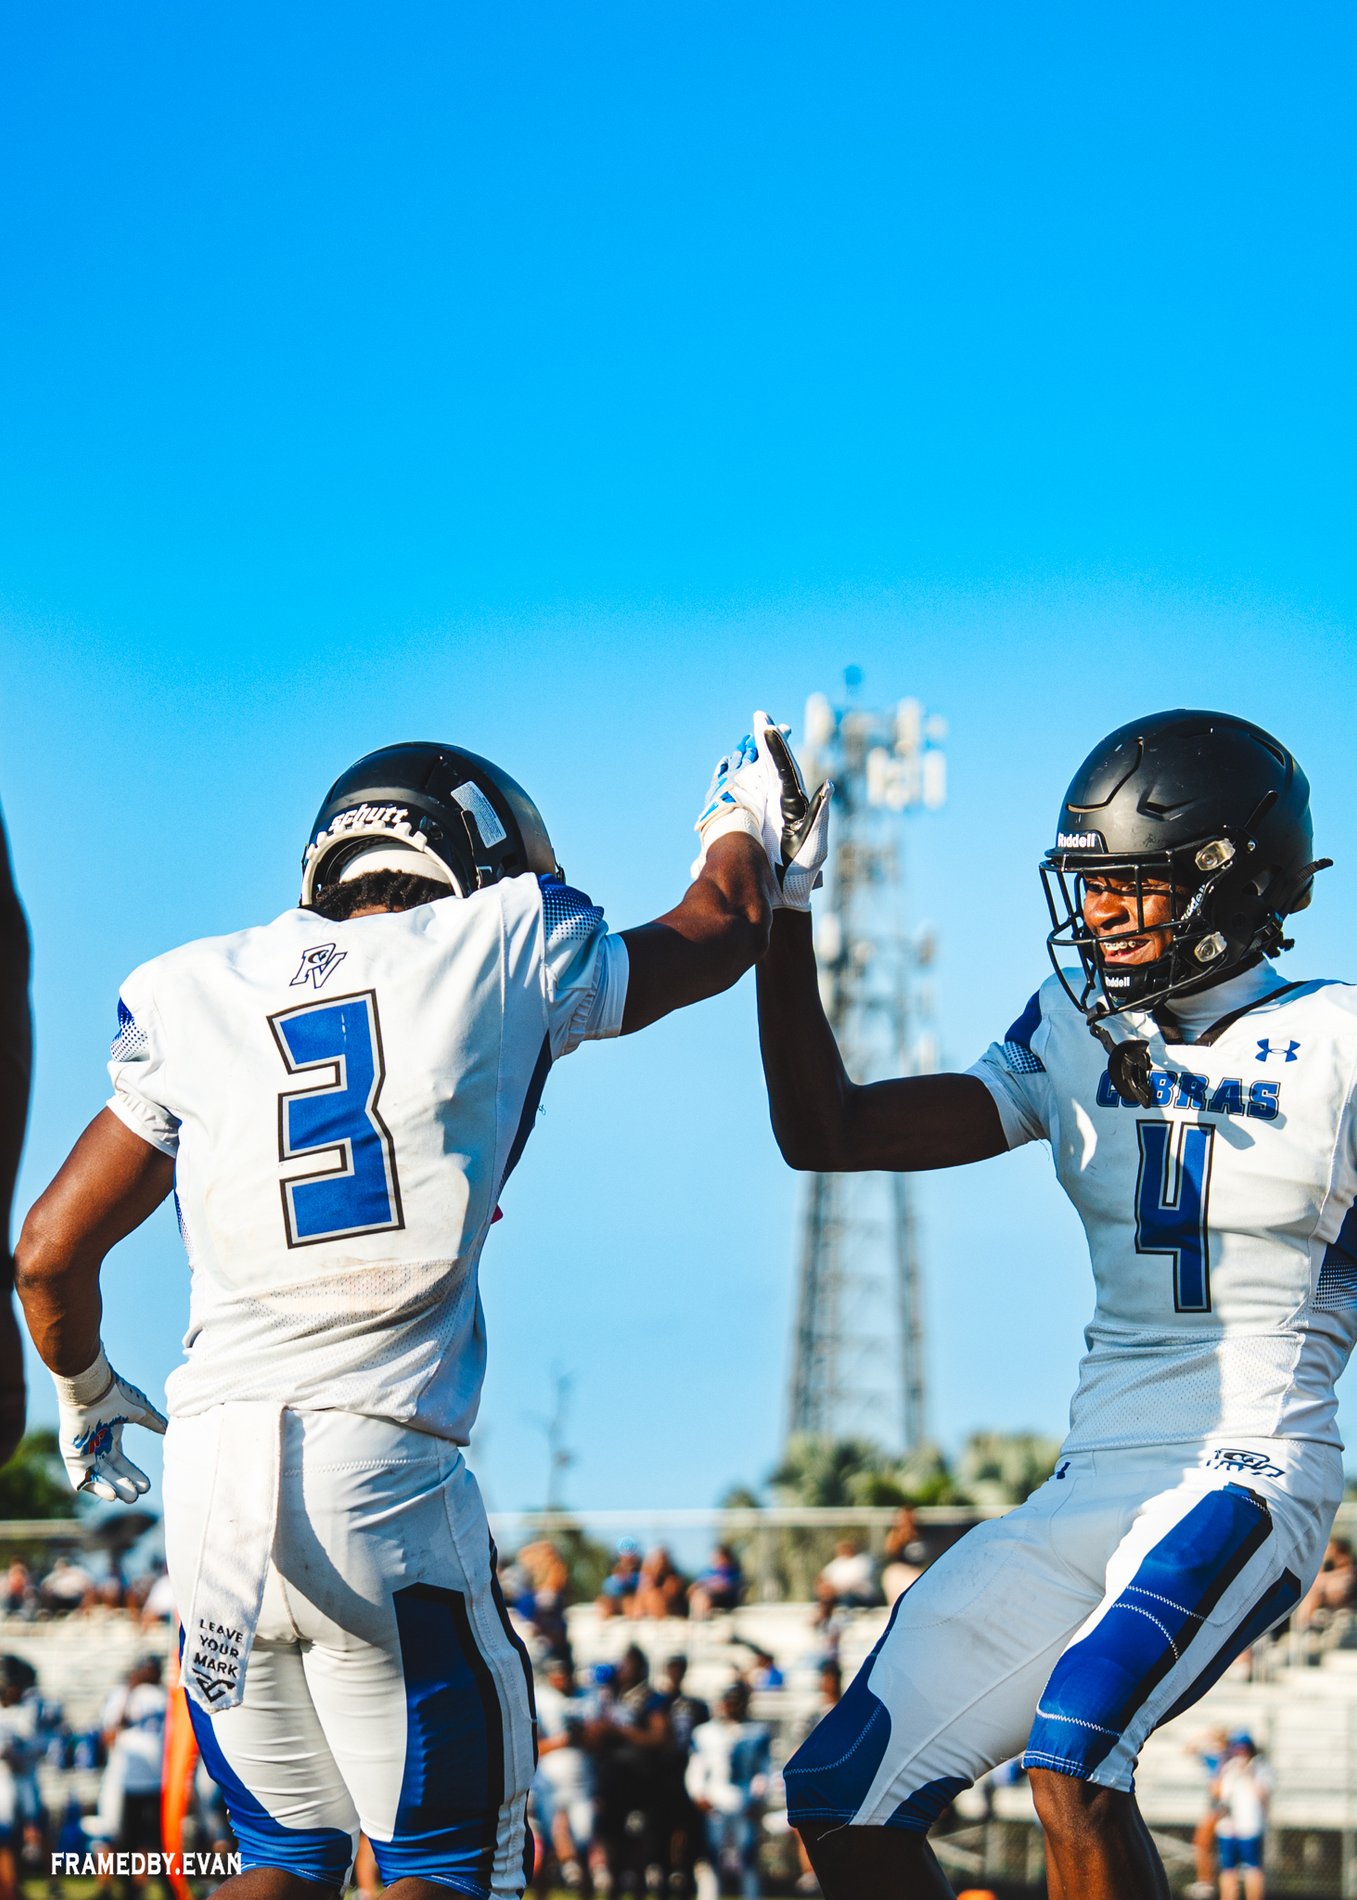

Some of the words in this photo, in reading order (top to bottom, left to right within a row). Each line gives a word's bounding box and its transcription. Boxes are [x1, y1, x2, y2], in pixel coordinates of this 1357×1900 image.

[1057, 831, 1097, 848] Riddell
[1096, 1069, 1281, 1121] CBRAS
[266, 988, 406, 1250] 3
[1134, 1119, 1216, 1314] 4
[200, 1619, 243, 1643] LEAVE
[199, 1634, 240, 1659] YOUR
[193, 1652, 238, 1679] MARK
